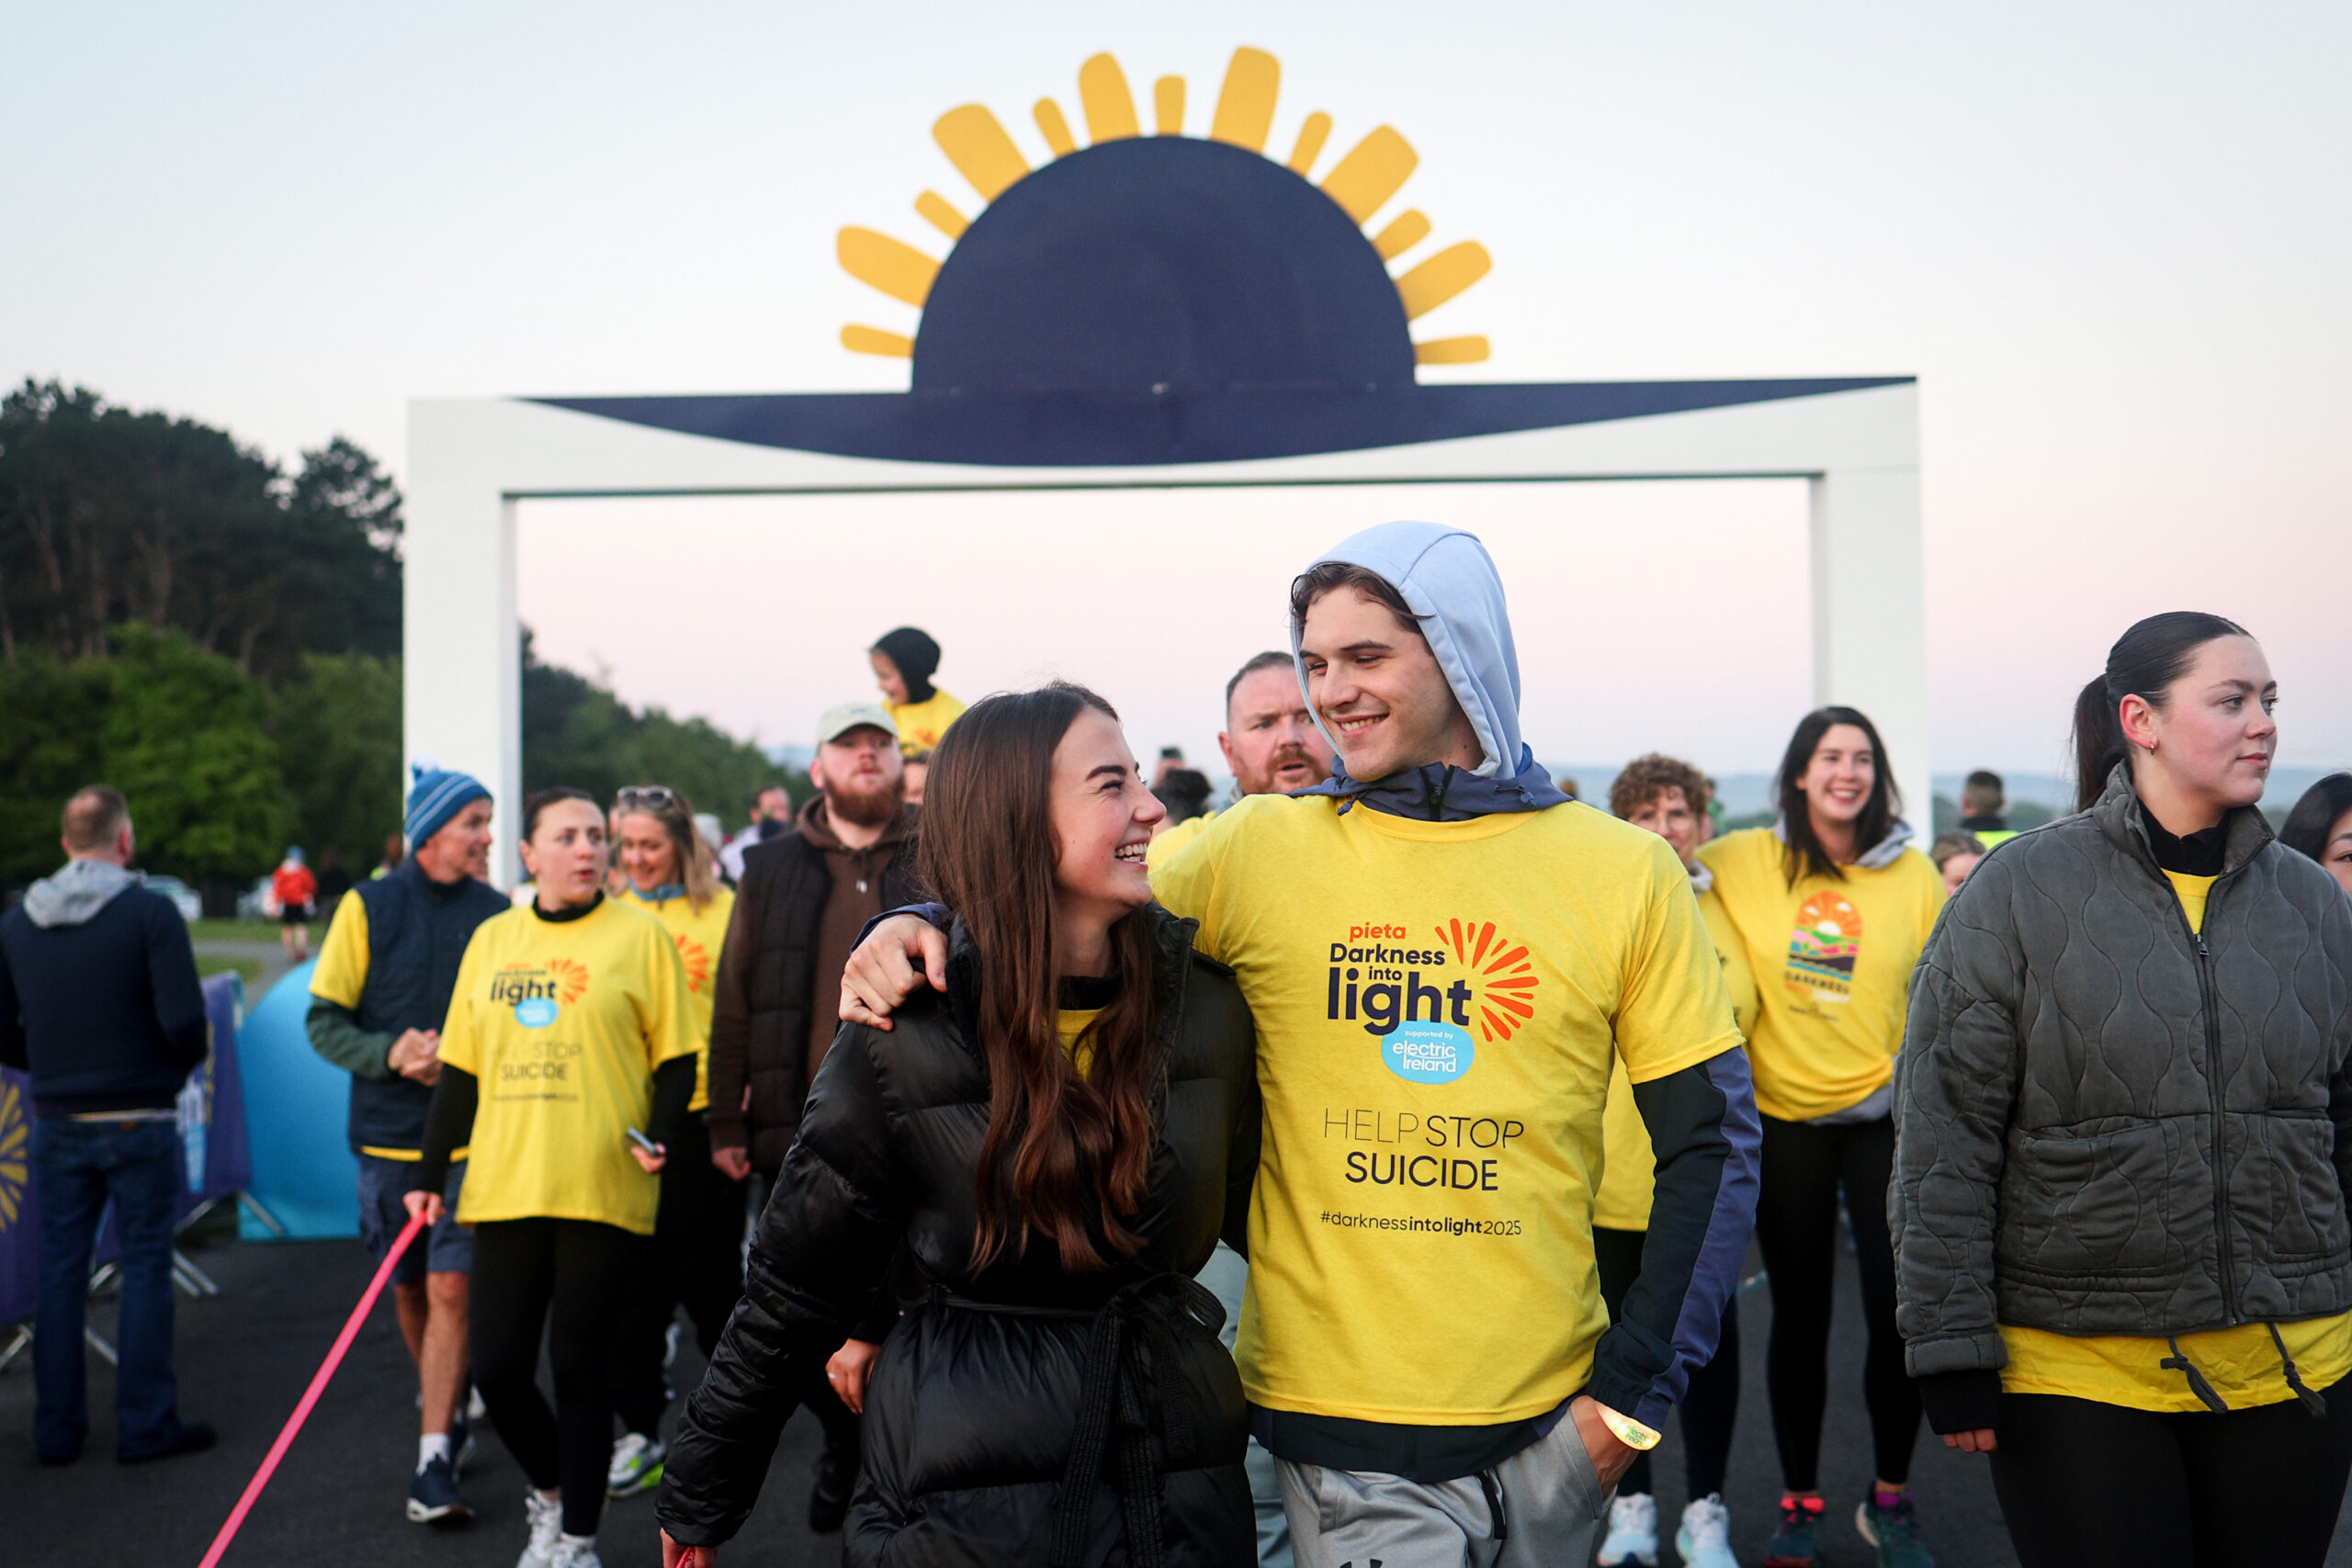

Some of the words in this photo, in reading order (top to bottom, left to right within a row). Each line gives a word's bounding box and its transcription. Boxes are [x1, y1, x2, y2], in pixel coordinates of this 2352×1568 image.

[1349, 921, 1407, 942] pieta
[1329, 942, 1445, 965] Darkness
[1368, 965, 1402, 980] into
[491, 980, 556, 1008] light
[1328, 966, 1472, 1035] light
[1405, 1030, 1442, 1039] supported
[1443, 1031, 1453, 1040] by
[1392, 1040, 1456, 1057] electric
[501, 1062, 568, 1081] SUICIDE
[1324, 1107, 1419, 1144] HELP
[1425, 1115, 1524, 1148] STOP
[1345, 1151, 1498, 1191] SUICIDE
[1320, 1211, 1521, 1235] #darknessintolight2025
